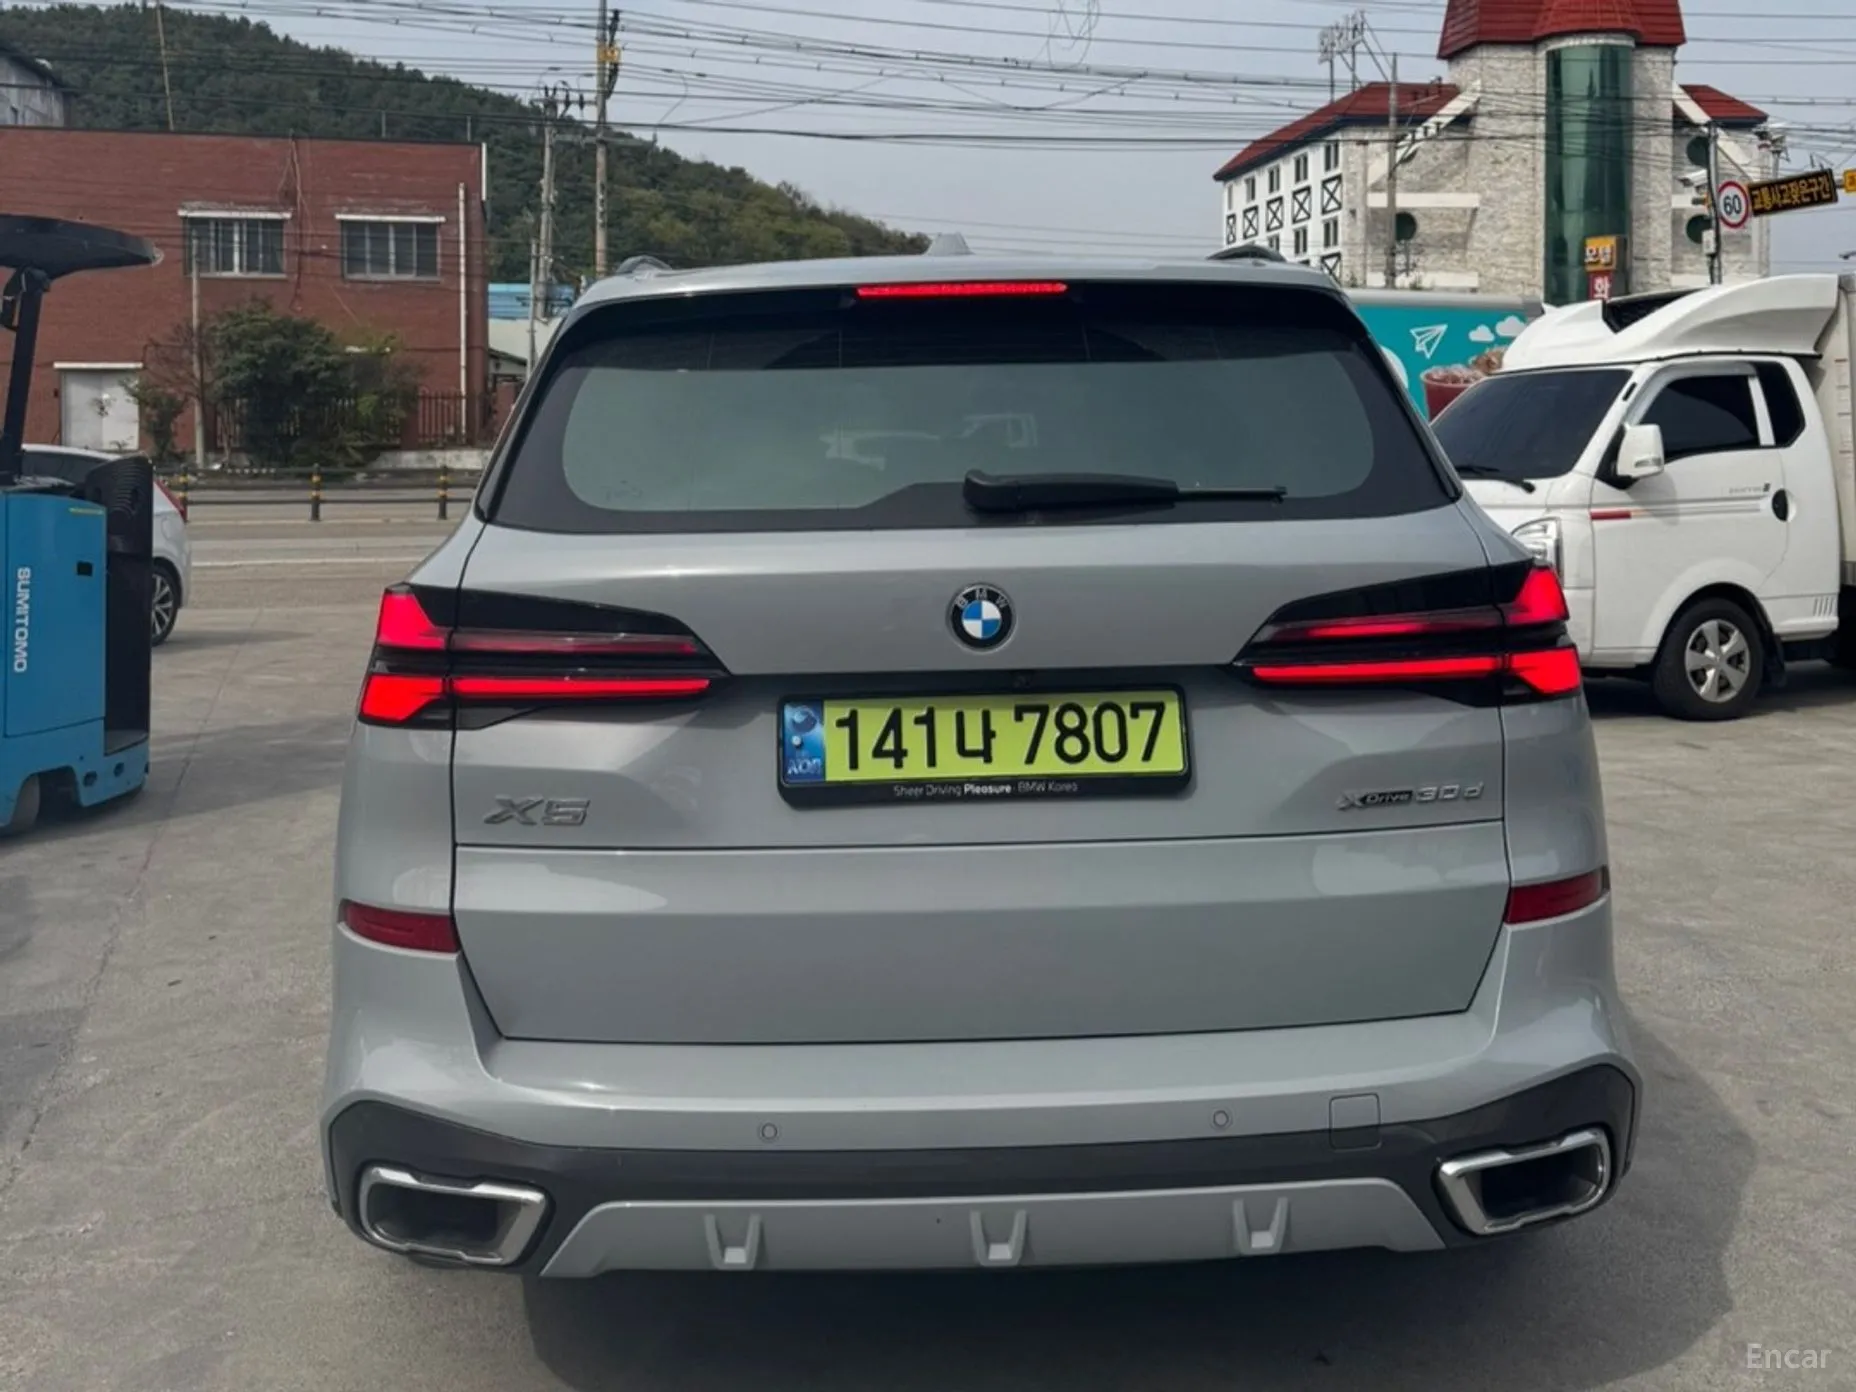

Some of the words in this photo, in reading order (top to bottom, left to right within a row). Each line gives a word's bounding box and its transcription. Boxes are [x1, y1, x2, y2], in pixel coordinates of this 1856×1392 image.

[1723, 194, 1742, 216] 60
[954, 586, 1010, 610] BMW
[14, 567, 31, 673] SUMITOMO
[835, 706, 997, 771] 141나
[1014, 702, 1166, 765] 7807
[926, 783, 962, 797] Driving
[964, 782, 1012, 795] Pleasure
[1018, 781, 1046, 793] BMW
[484, 795, 591, 826] X5
